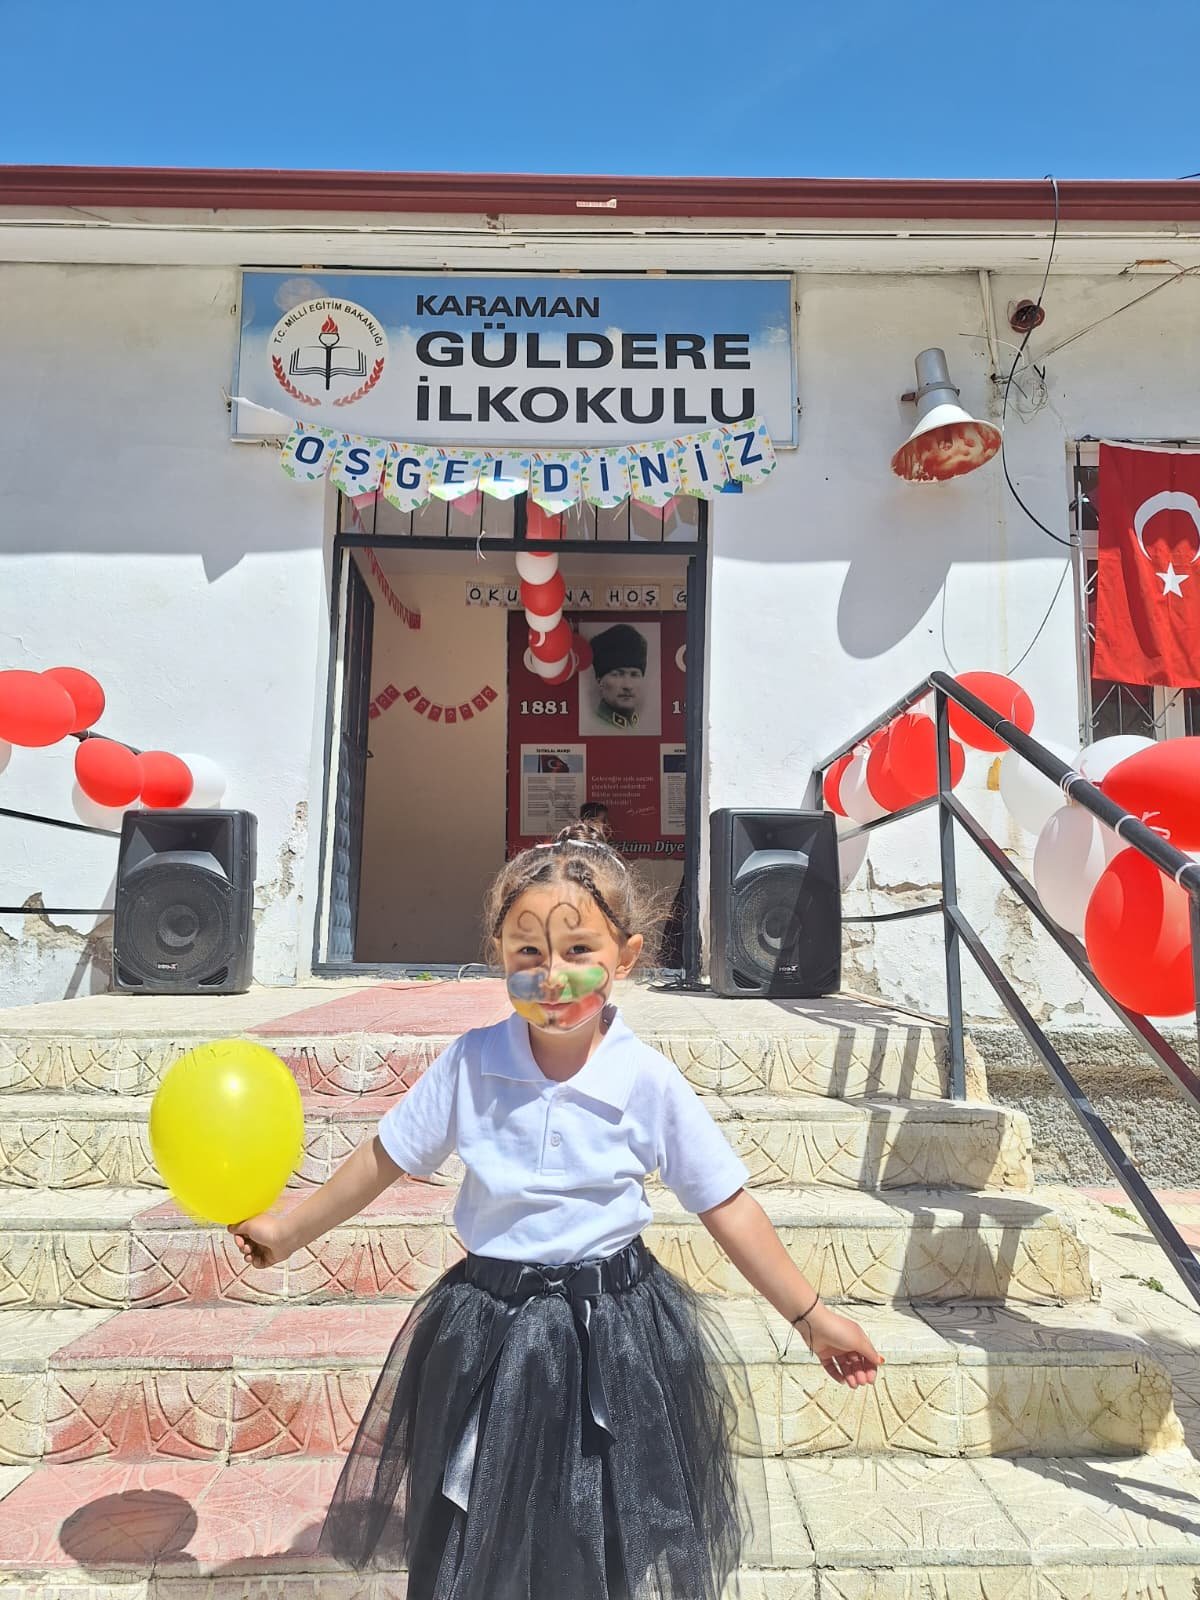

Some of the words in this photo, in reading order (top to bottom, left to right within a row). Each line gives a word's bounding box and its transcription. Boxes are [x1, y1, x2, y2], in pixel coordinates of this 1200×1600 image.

[309, 300, 342, 312] EĞİTİM
[344, 305, 384, 346] BAKANLIĞI
[415, 294, 600, 318] KARAMAN
[415, 322, 751, 370] GÜLDERE
[415, 375, 756, 424] İLKOKULU
[469, 588, 591, 603] OKUNA
[609, 589, 657, 606] HOŞ
[520, 700, 569, 715] 1881
